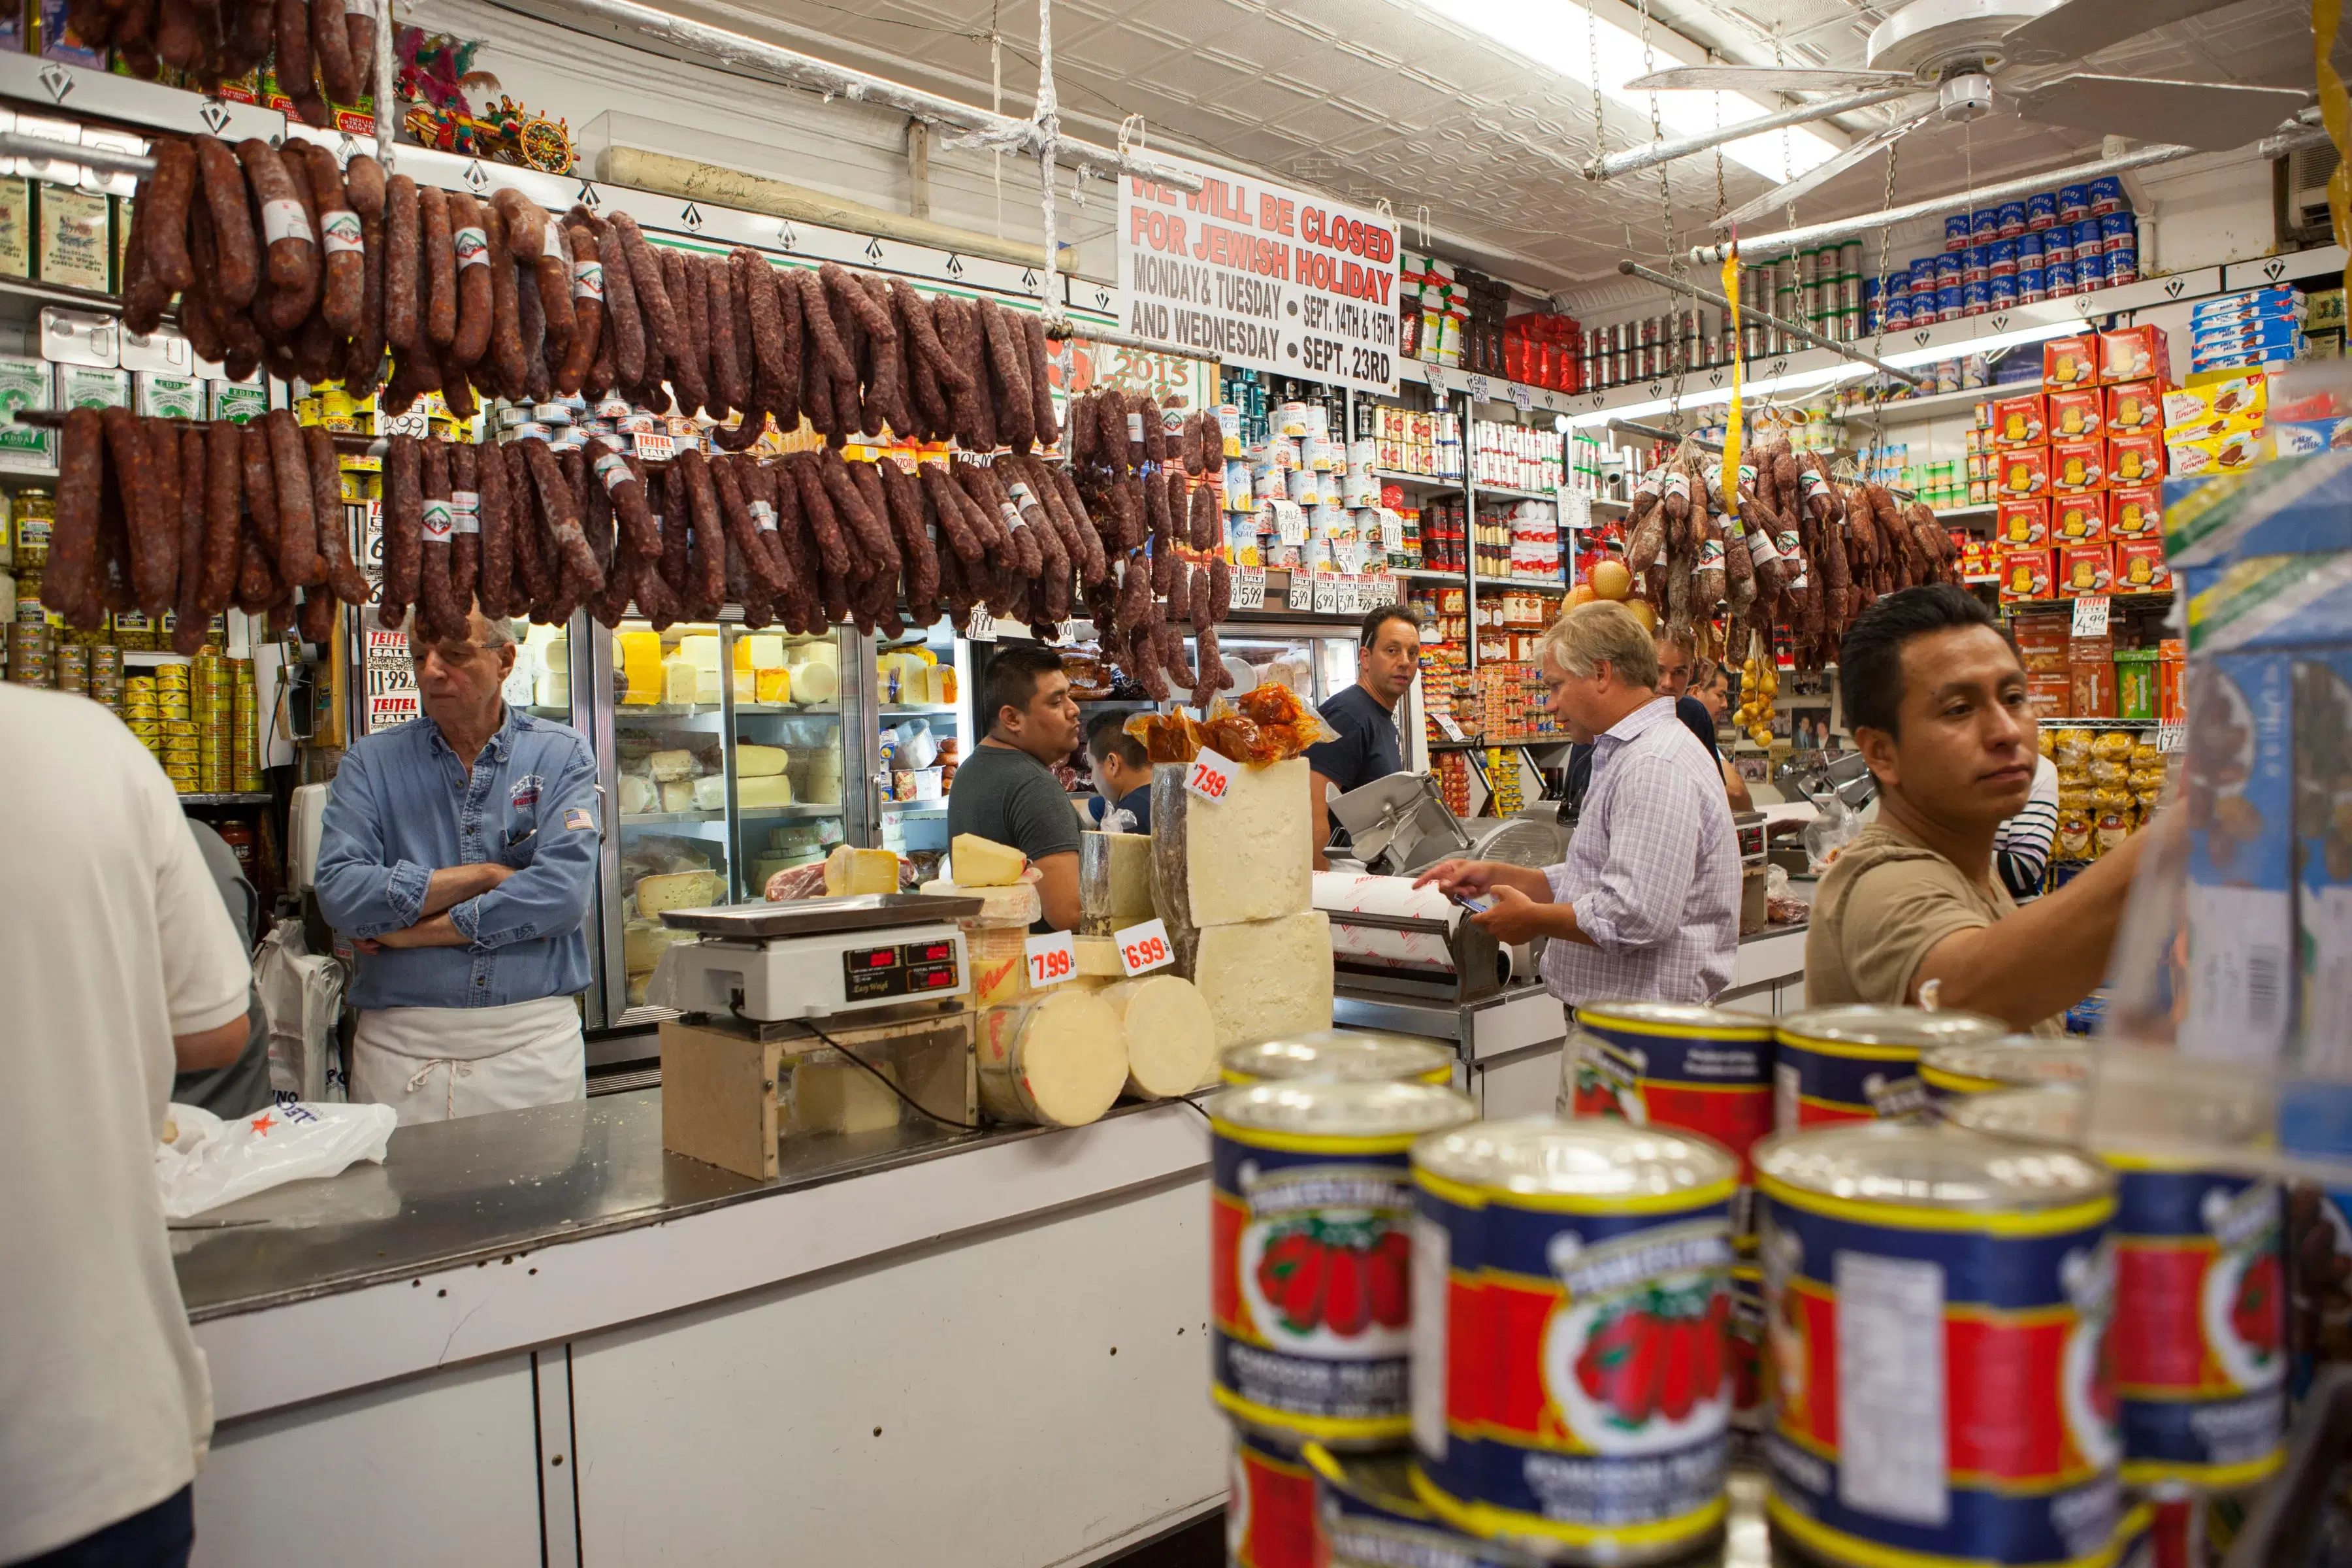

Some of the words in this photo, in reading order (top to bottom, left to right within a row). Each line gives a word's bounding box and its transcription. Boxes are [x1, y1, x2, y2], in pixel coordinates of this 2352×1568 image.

[1131, 174, 1176, 206] WE
[1184, 171, 1253, 226] WILL
[1260, 193, 1294, 237] BE
[1301, 206, 1394, 264] CLOSED
[1131, 205, 1188, 257] FOR
[1193, 223, 1289, 281] JEWISH
[1296, 248, 1394, 306] HOLIDAY
[1217, 270, 1281, 321] TUESDAY
[1304, 294, 1331, 332] SEPT.
[1335, 301, 1359, 338] 14TH
[1362, 308, 1369, 340] &
[1372, 311, 1394, 346] 15TH
[1130, 300, 1169, 340] AND
[1174, 308, 1280, 361] WEDNESDAY
[1303, 335, 1348, 376] SEPT.
[1352, 346, 1390, 384] 23RD
[1114, 353, 1188, 387] 2015
[1473, 375, 1487, 385] SALE
[233, 387, 258, 398] EDDA
[2060, 395, 2089, 404] Bellamore
[2003, 402, 2032, 411] Bellamore
[2181, 401, 2197, 410] Mini
[638, 436, 672, 449] TEITEL
[2119, 439, 2149, 448] Bellamore
[640, 448, 674, 459] SALE
[2187, 454, 2201, 463] Mini
[2120, 492, 2150, 500] Bellamore
[1279, 510, 1299, 520] SALE
[1381, 514, 1399, 525] SALE
[2127, 544, 2159, 553] Bellamore
[1243, 566, 1264, 576] TEITEL
[1293, 568, 1311, 579] TEITEL
[1316, 572, 1335, 582] TEITEL
[1339, 574, 1355, 582] TEITEL
[1358, 575, 1375, 584] TEITEL
[1378, 574, 1394, 583] TEITEL
[1241, 588, 1262, 606] 5.99
[371, 632, 407, 647] TEITE
[372, 648, 412, 658] SALE
[373, 698, 417, 713] TEITEL
[374, 715, 417, 724] SALE
